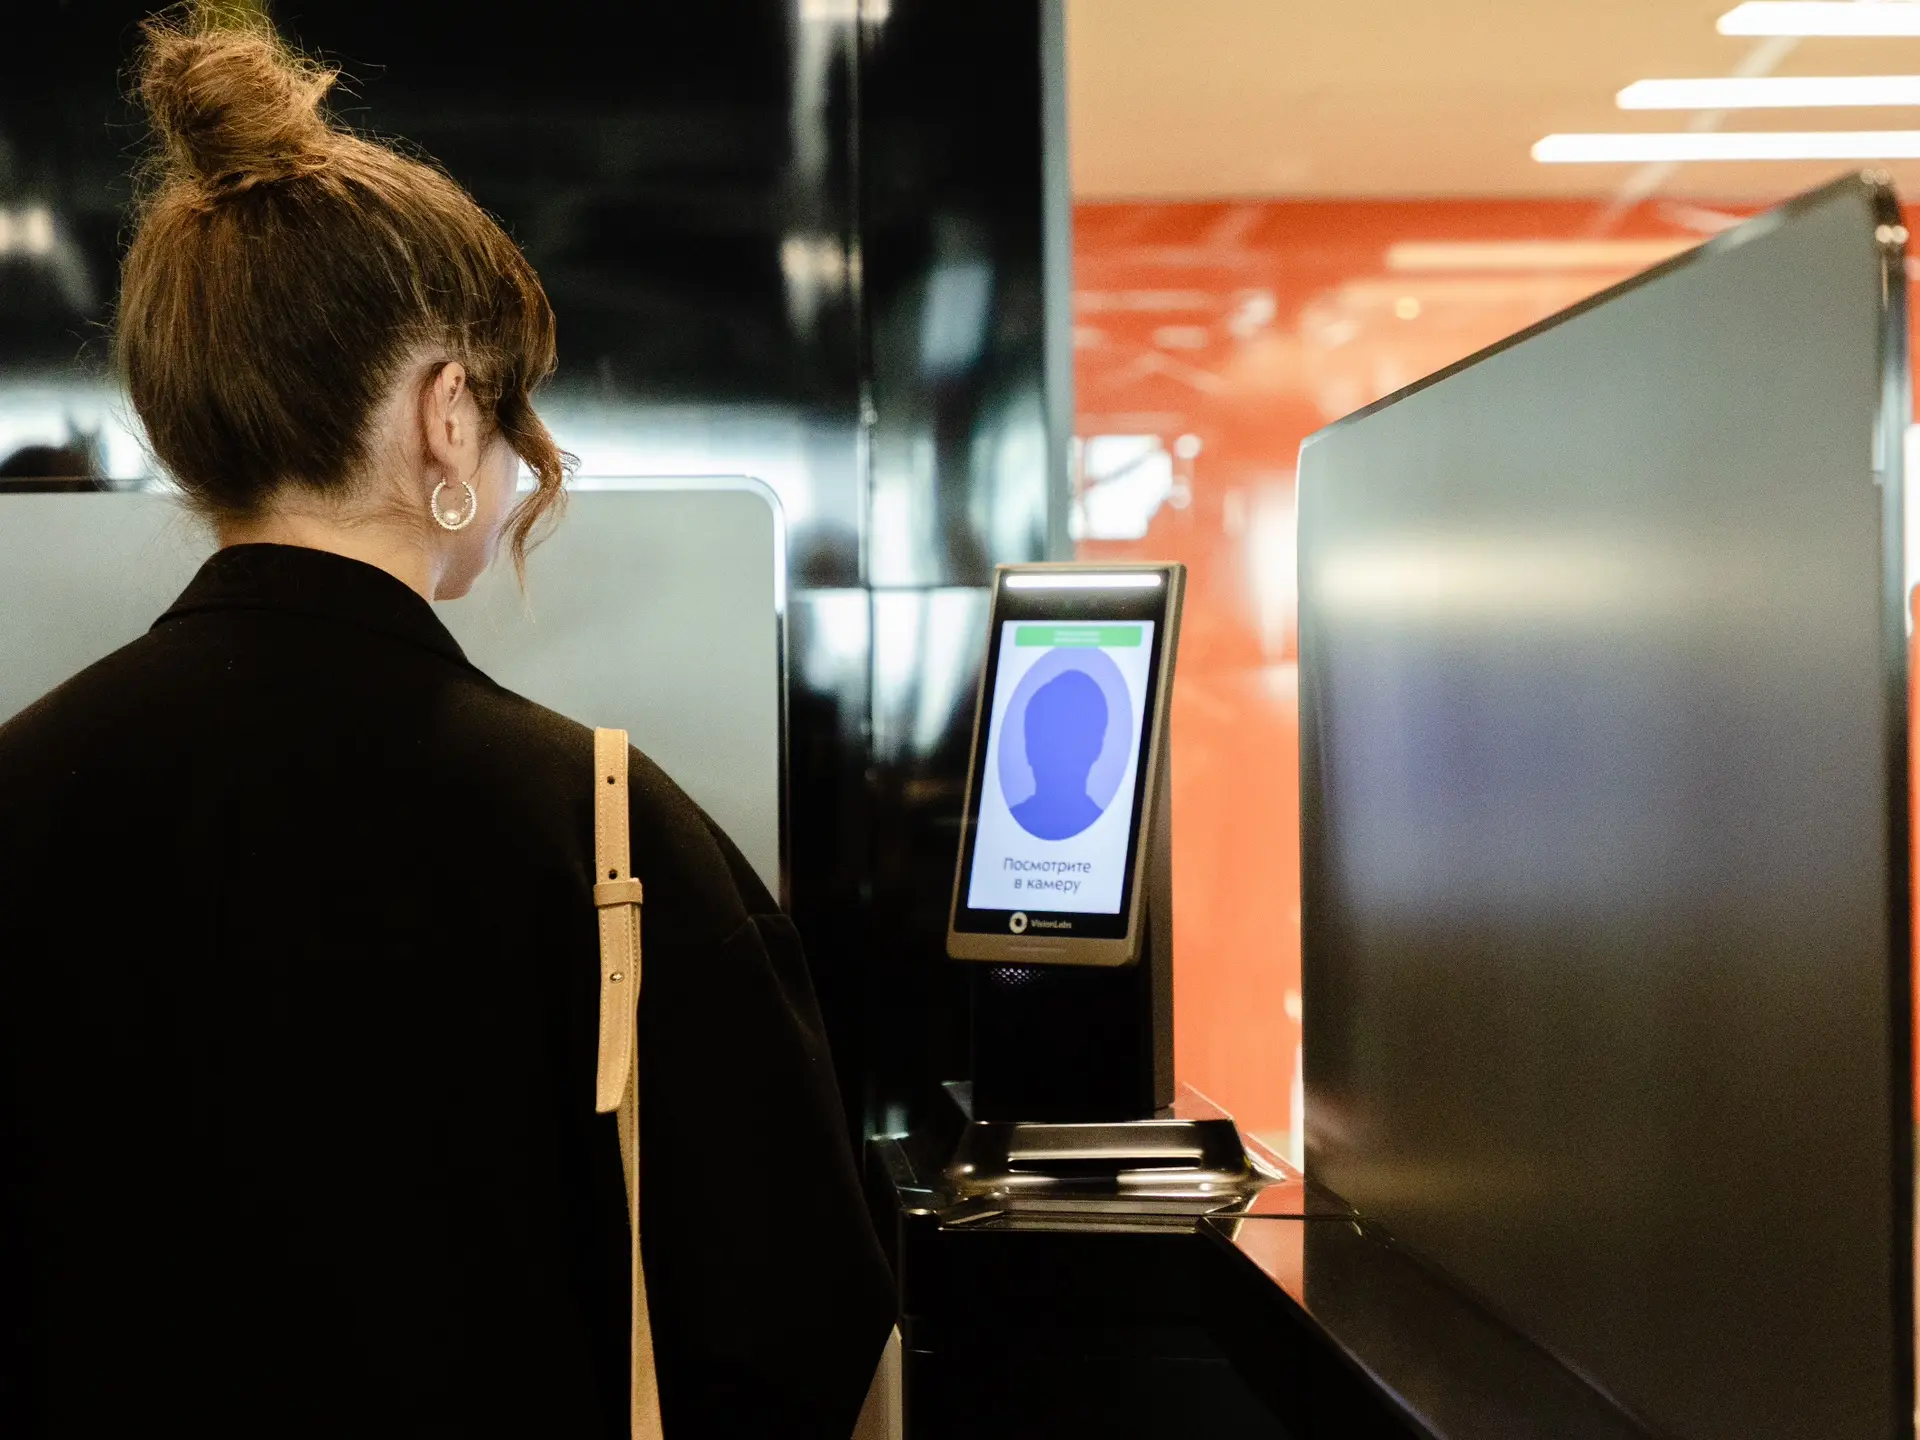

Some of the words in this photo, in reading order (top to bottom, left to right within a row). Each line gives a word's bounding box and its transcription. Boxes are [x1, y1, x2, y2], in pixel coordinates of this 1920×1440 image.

[1003, 857, 1091, 875] Посмотрите
[1014, 879, 1022, 889] в
[1027, 879, 1082, 894] камеру
[1030, 919, 1072, 929] VisionLabs
